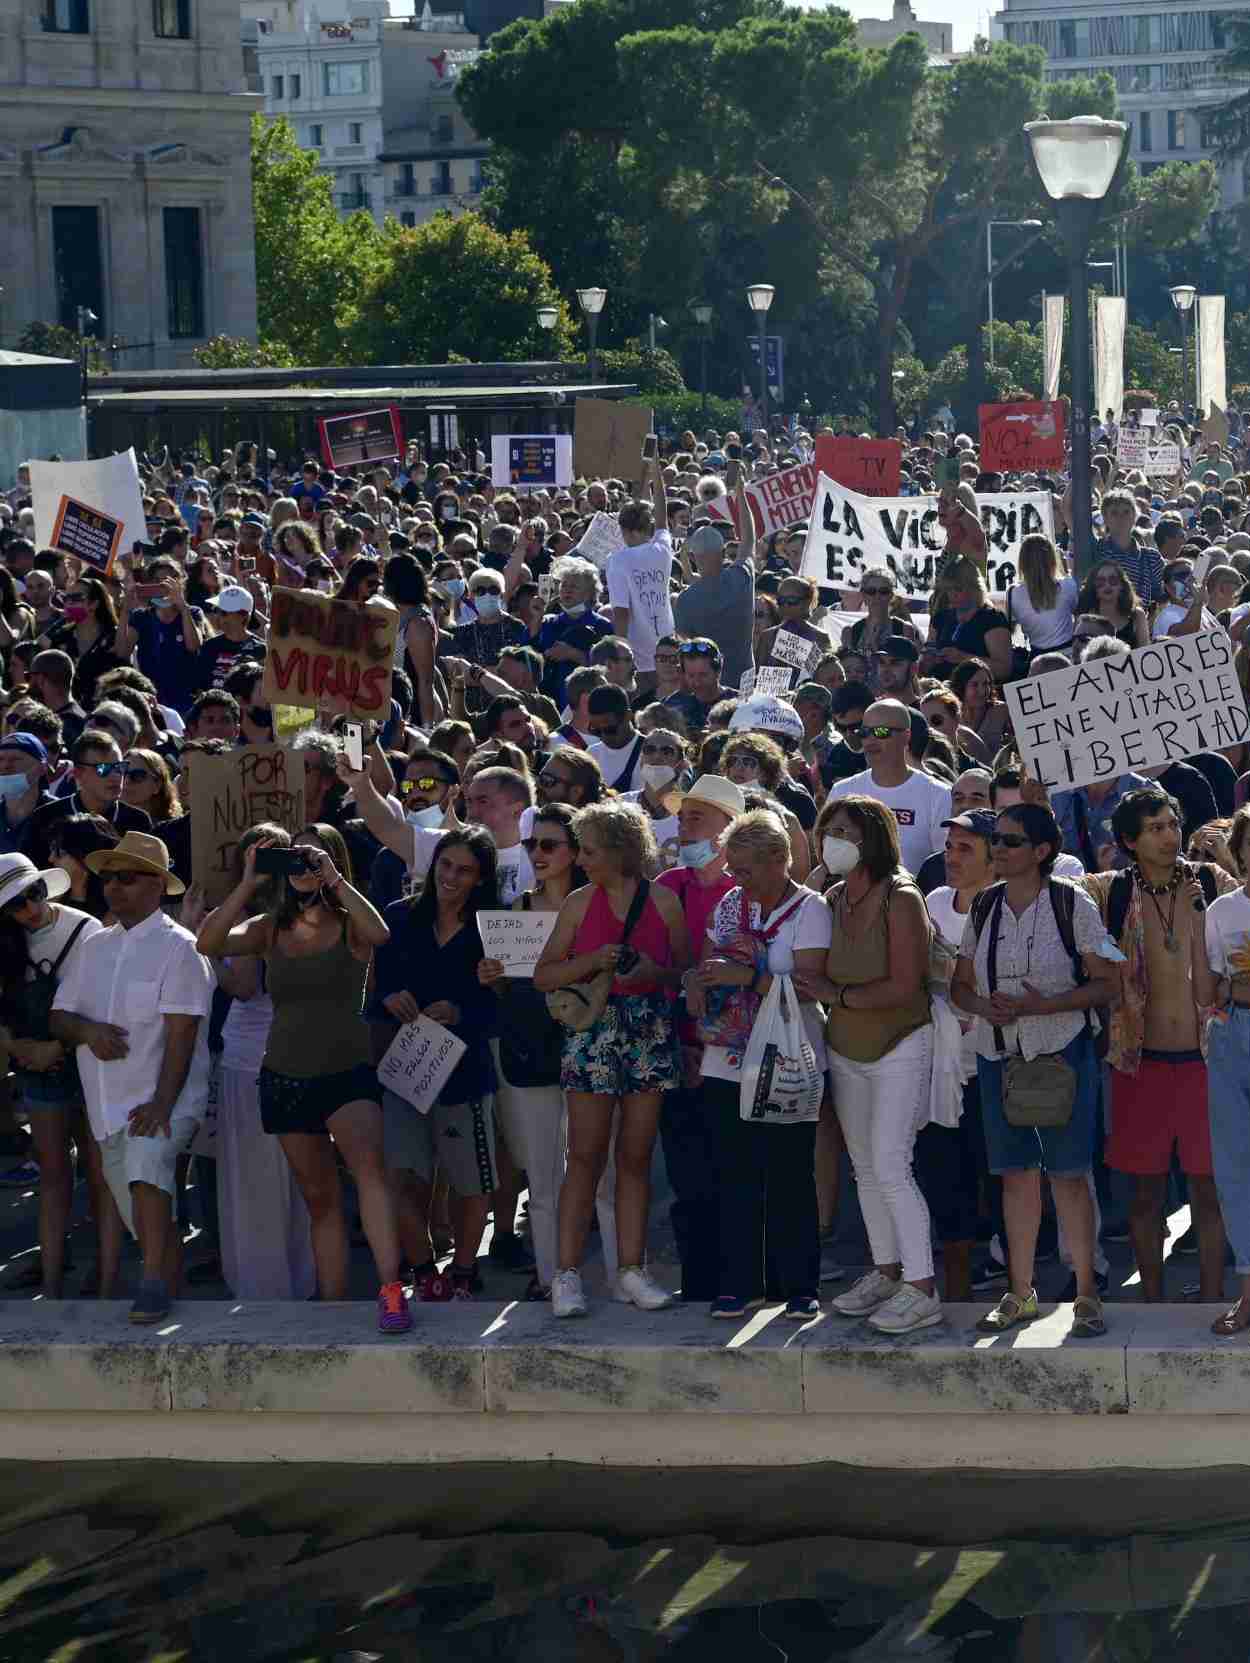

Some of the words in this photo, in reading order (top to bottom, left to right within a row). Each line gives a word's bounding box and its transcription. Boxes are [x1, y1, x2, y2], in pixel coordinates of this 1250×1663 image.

[823, 492, 864, 541] LA
[878, 502, 1044, 552] VICRIA
[825, 543, 867, 588] ES
[271, 647, 388, 712] VIRUS
[1016, 683, 1056, 716] EL
[1067, 643, 1192, 701] AMOR
[1196, 631, 1229, 670] ES
[1026, 673, 1235, 748] INEVITABLE
[238, 750, 288, 790] POR
[1032, 706, 1249, 787] LIBERTAD
[535, 919, 544, 928] A
[384, 1055, 402, 1081] NO
[413, 1038, 454, 1096] POSITIVOS
